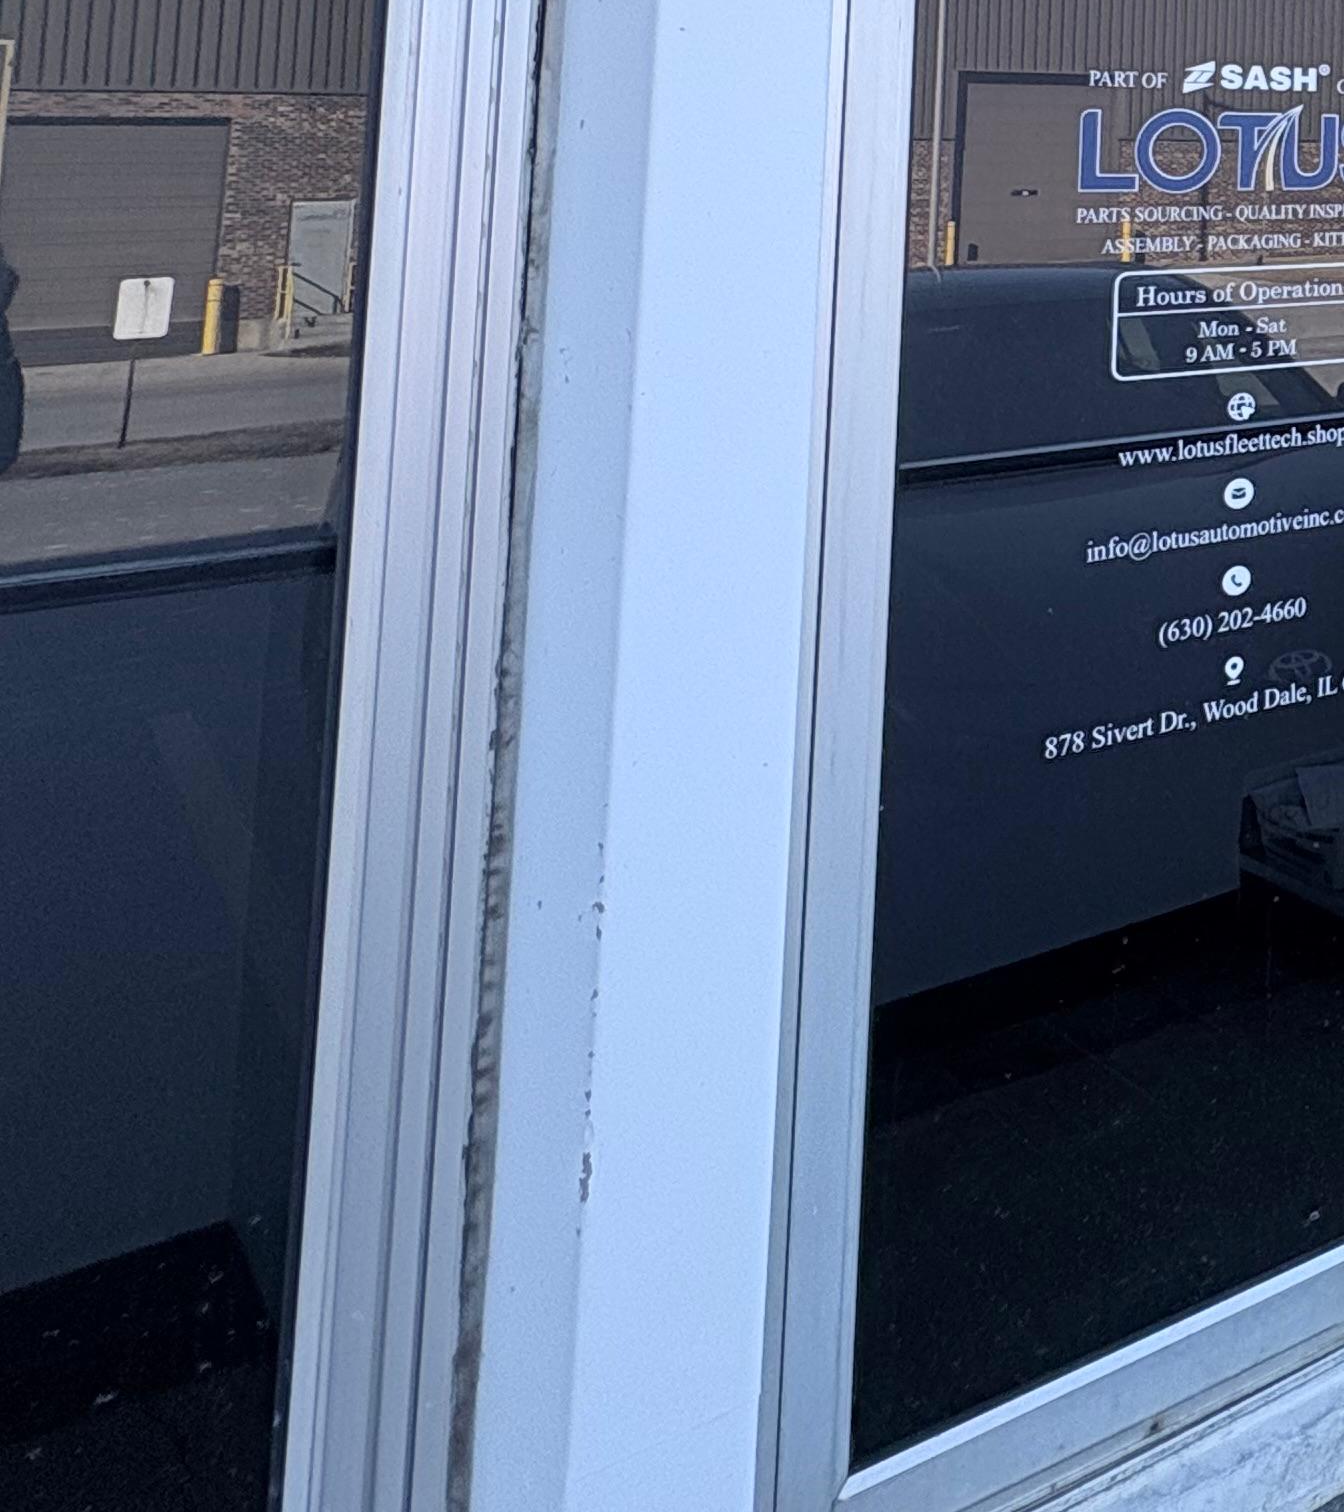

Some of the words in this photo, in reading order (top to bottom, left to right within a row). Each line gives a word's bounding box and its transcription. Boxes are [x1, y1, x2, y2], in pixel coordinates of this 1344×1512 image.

[1088, 69, 1139, 88] PART
[1141, 72, 1169, 89] OF
[1076, 207, 1131, 224] PARTS
[1134, 205, 1223, 223] SOURCING
[1235, 203, 1308, 223] QUALITY
[1101, 235, 1196, 255] ASSEMBLY
[1207, 232, 1302, 251] PACKAGING
[1135, 286, 1207, 307] Hours
[1213, 285, 1234, 303] of
[1239, 278, 1344, 304] Operation
[1197, 321, 1240, 339] Mon
[1255, 316, 1287, 335] Sat
[1185, 346, 1197, 364] 9
[1201, 344, 1235, 363] AM
[1250, 340, 1262, 359] 5
[1267, 338, 1297, 357] PM
[1157, 614, 1213, 649] (630)
[1217, 595, 1308, 634] 202-4660
[1043, 730, 1085, 760] 878
[1091, 716, 1155, 750] Sivert
[1160, 708, 1197, 734] Dr.,
[1203, 694, 1259, 724] Wood
[1264, 681, 1313, 711] Dale,
[1316, 674, 1338, 698] IL
